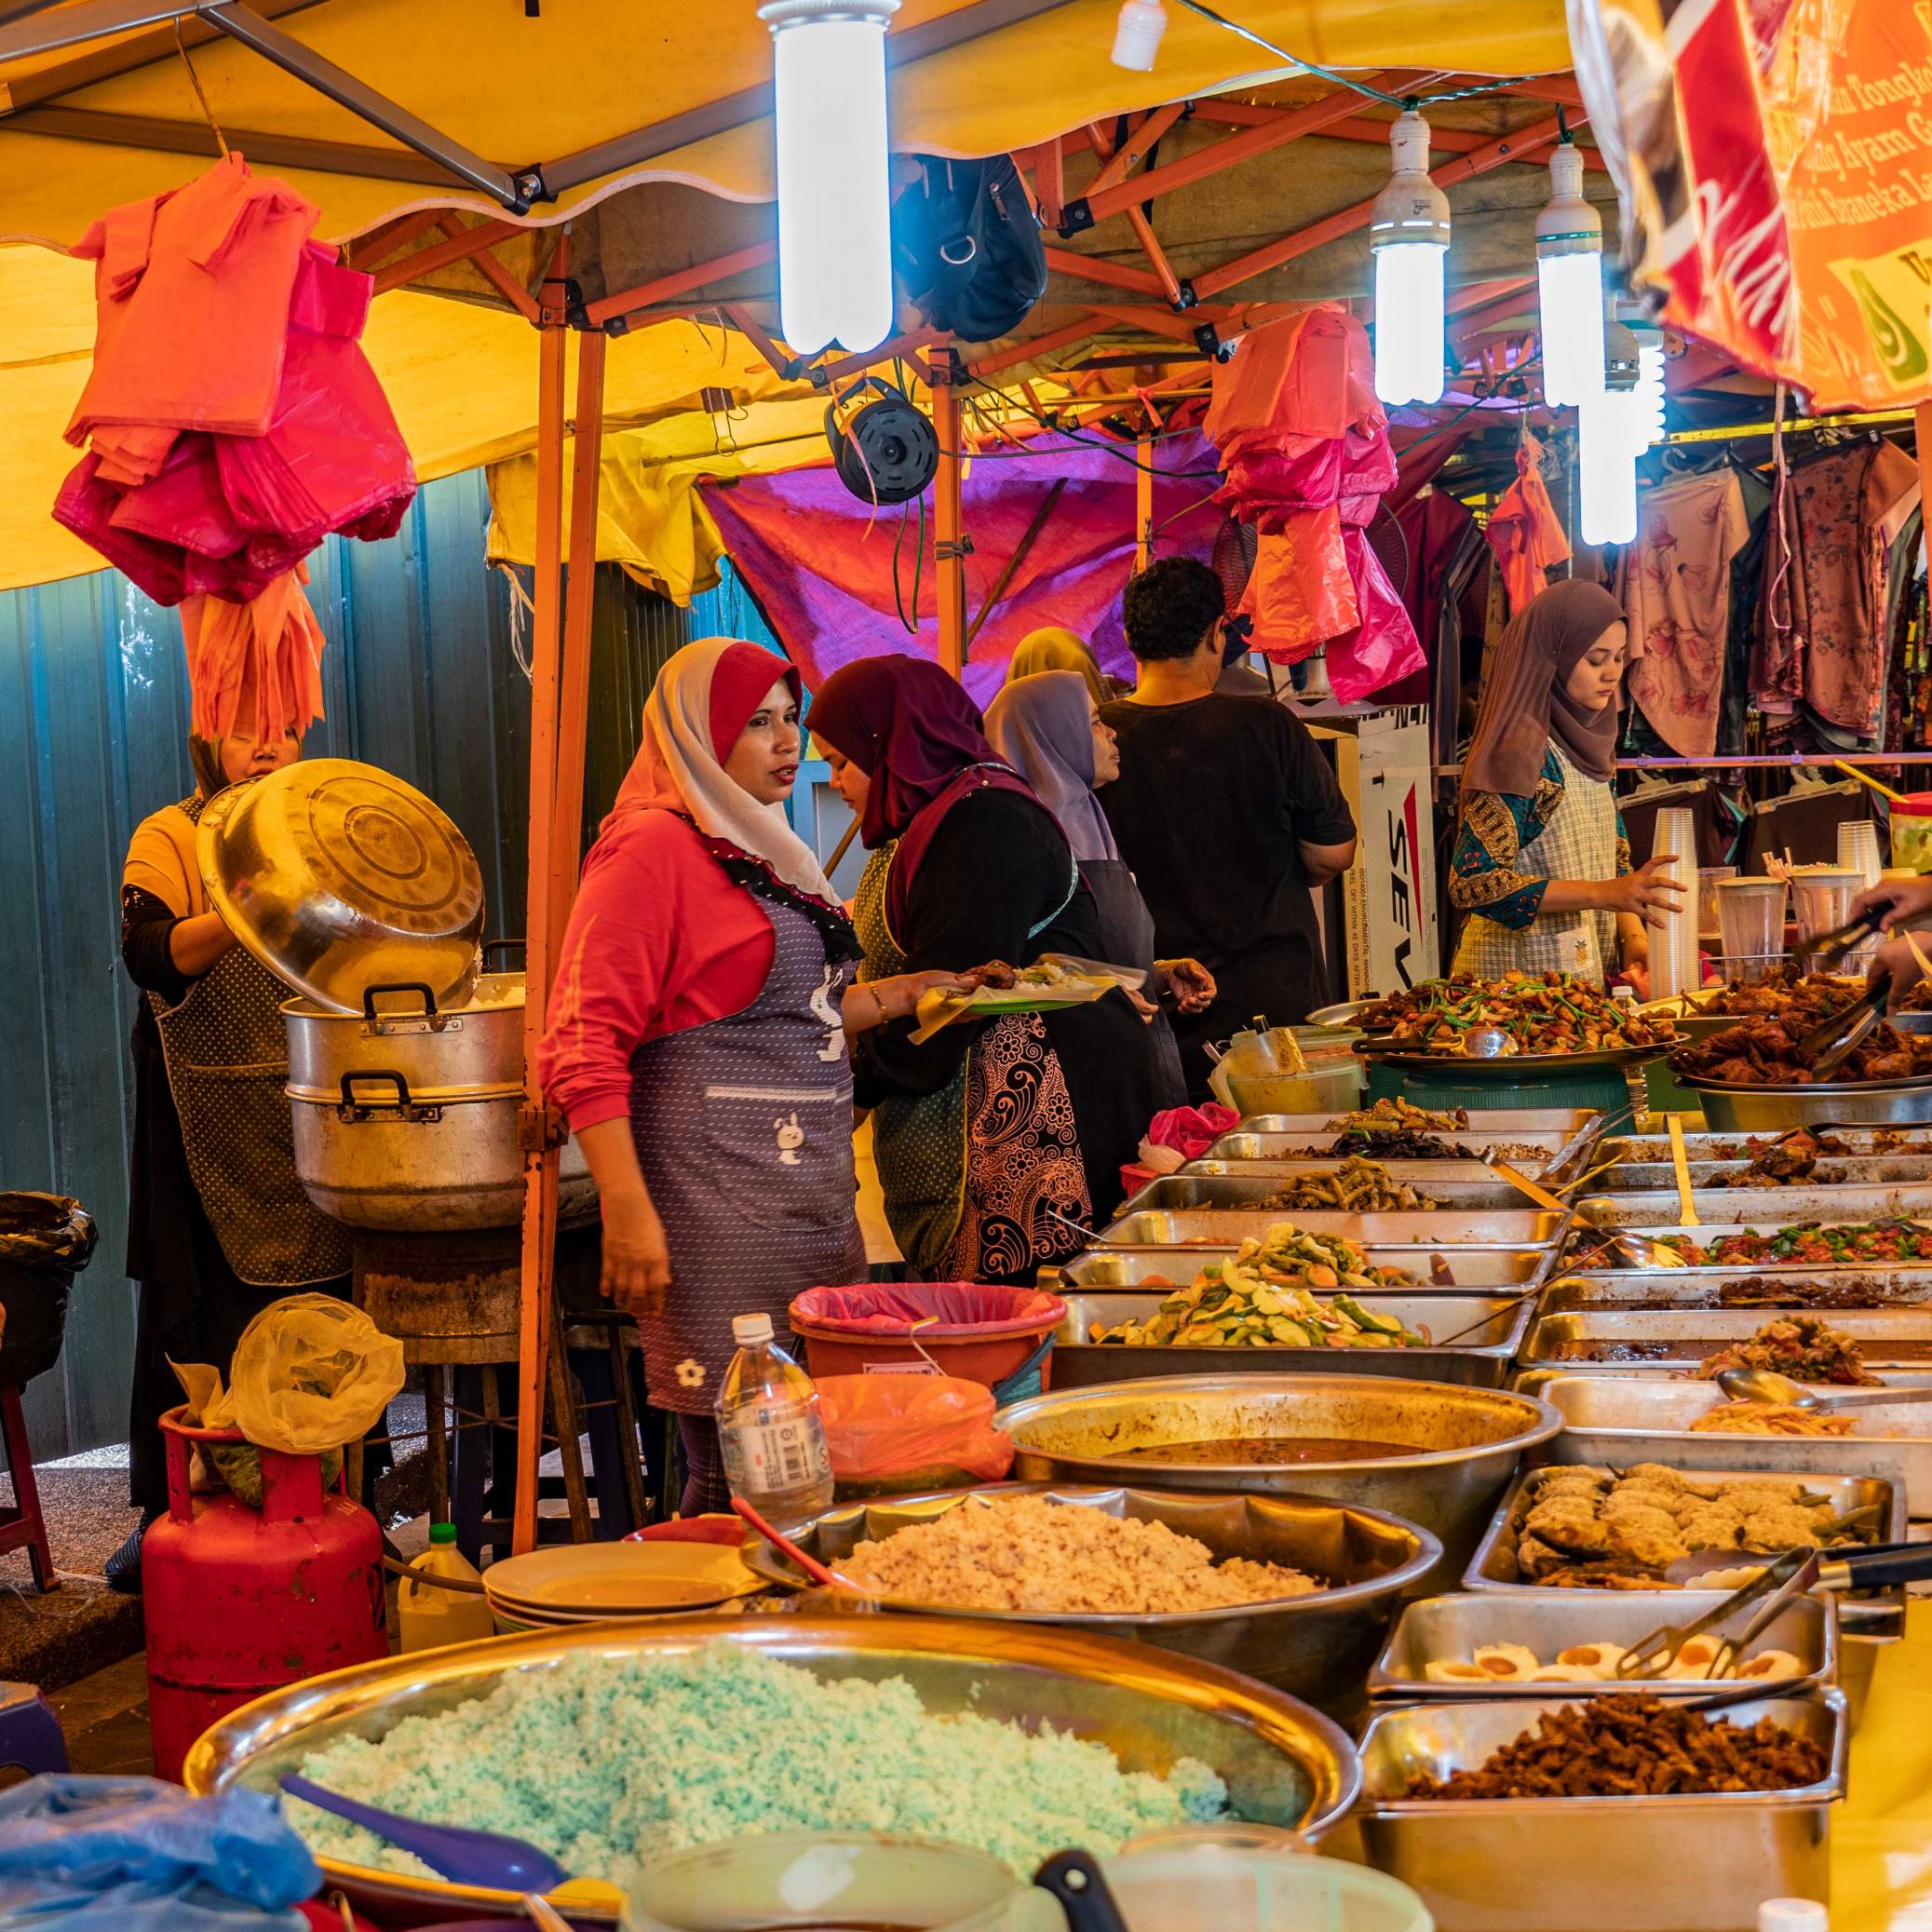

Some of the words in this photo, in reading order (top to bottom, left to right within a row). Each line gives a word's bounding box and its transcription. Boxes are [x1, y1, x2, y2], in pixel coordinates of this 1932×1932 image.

[1845, 55, 1932, 111] Tongko
[1832, 130, 1917, 177] Ayam
[1352, 932, 1358, 940] 45
